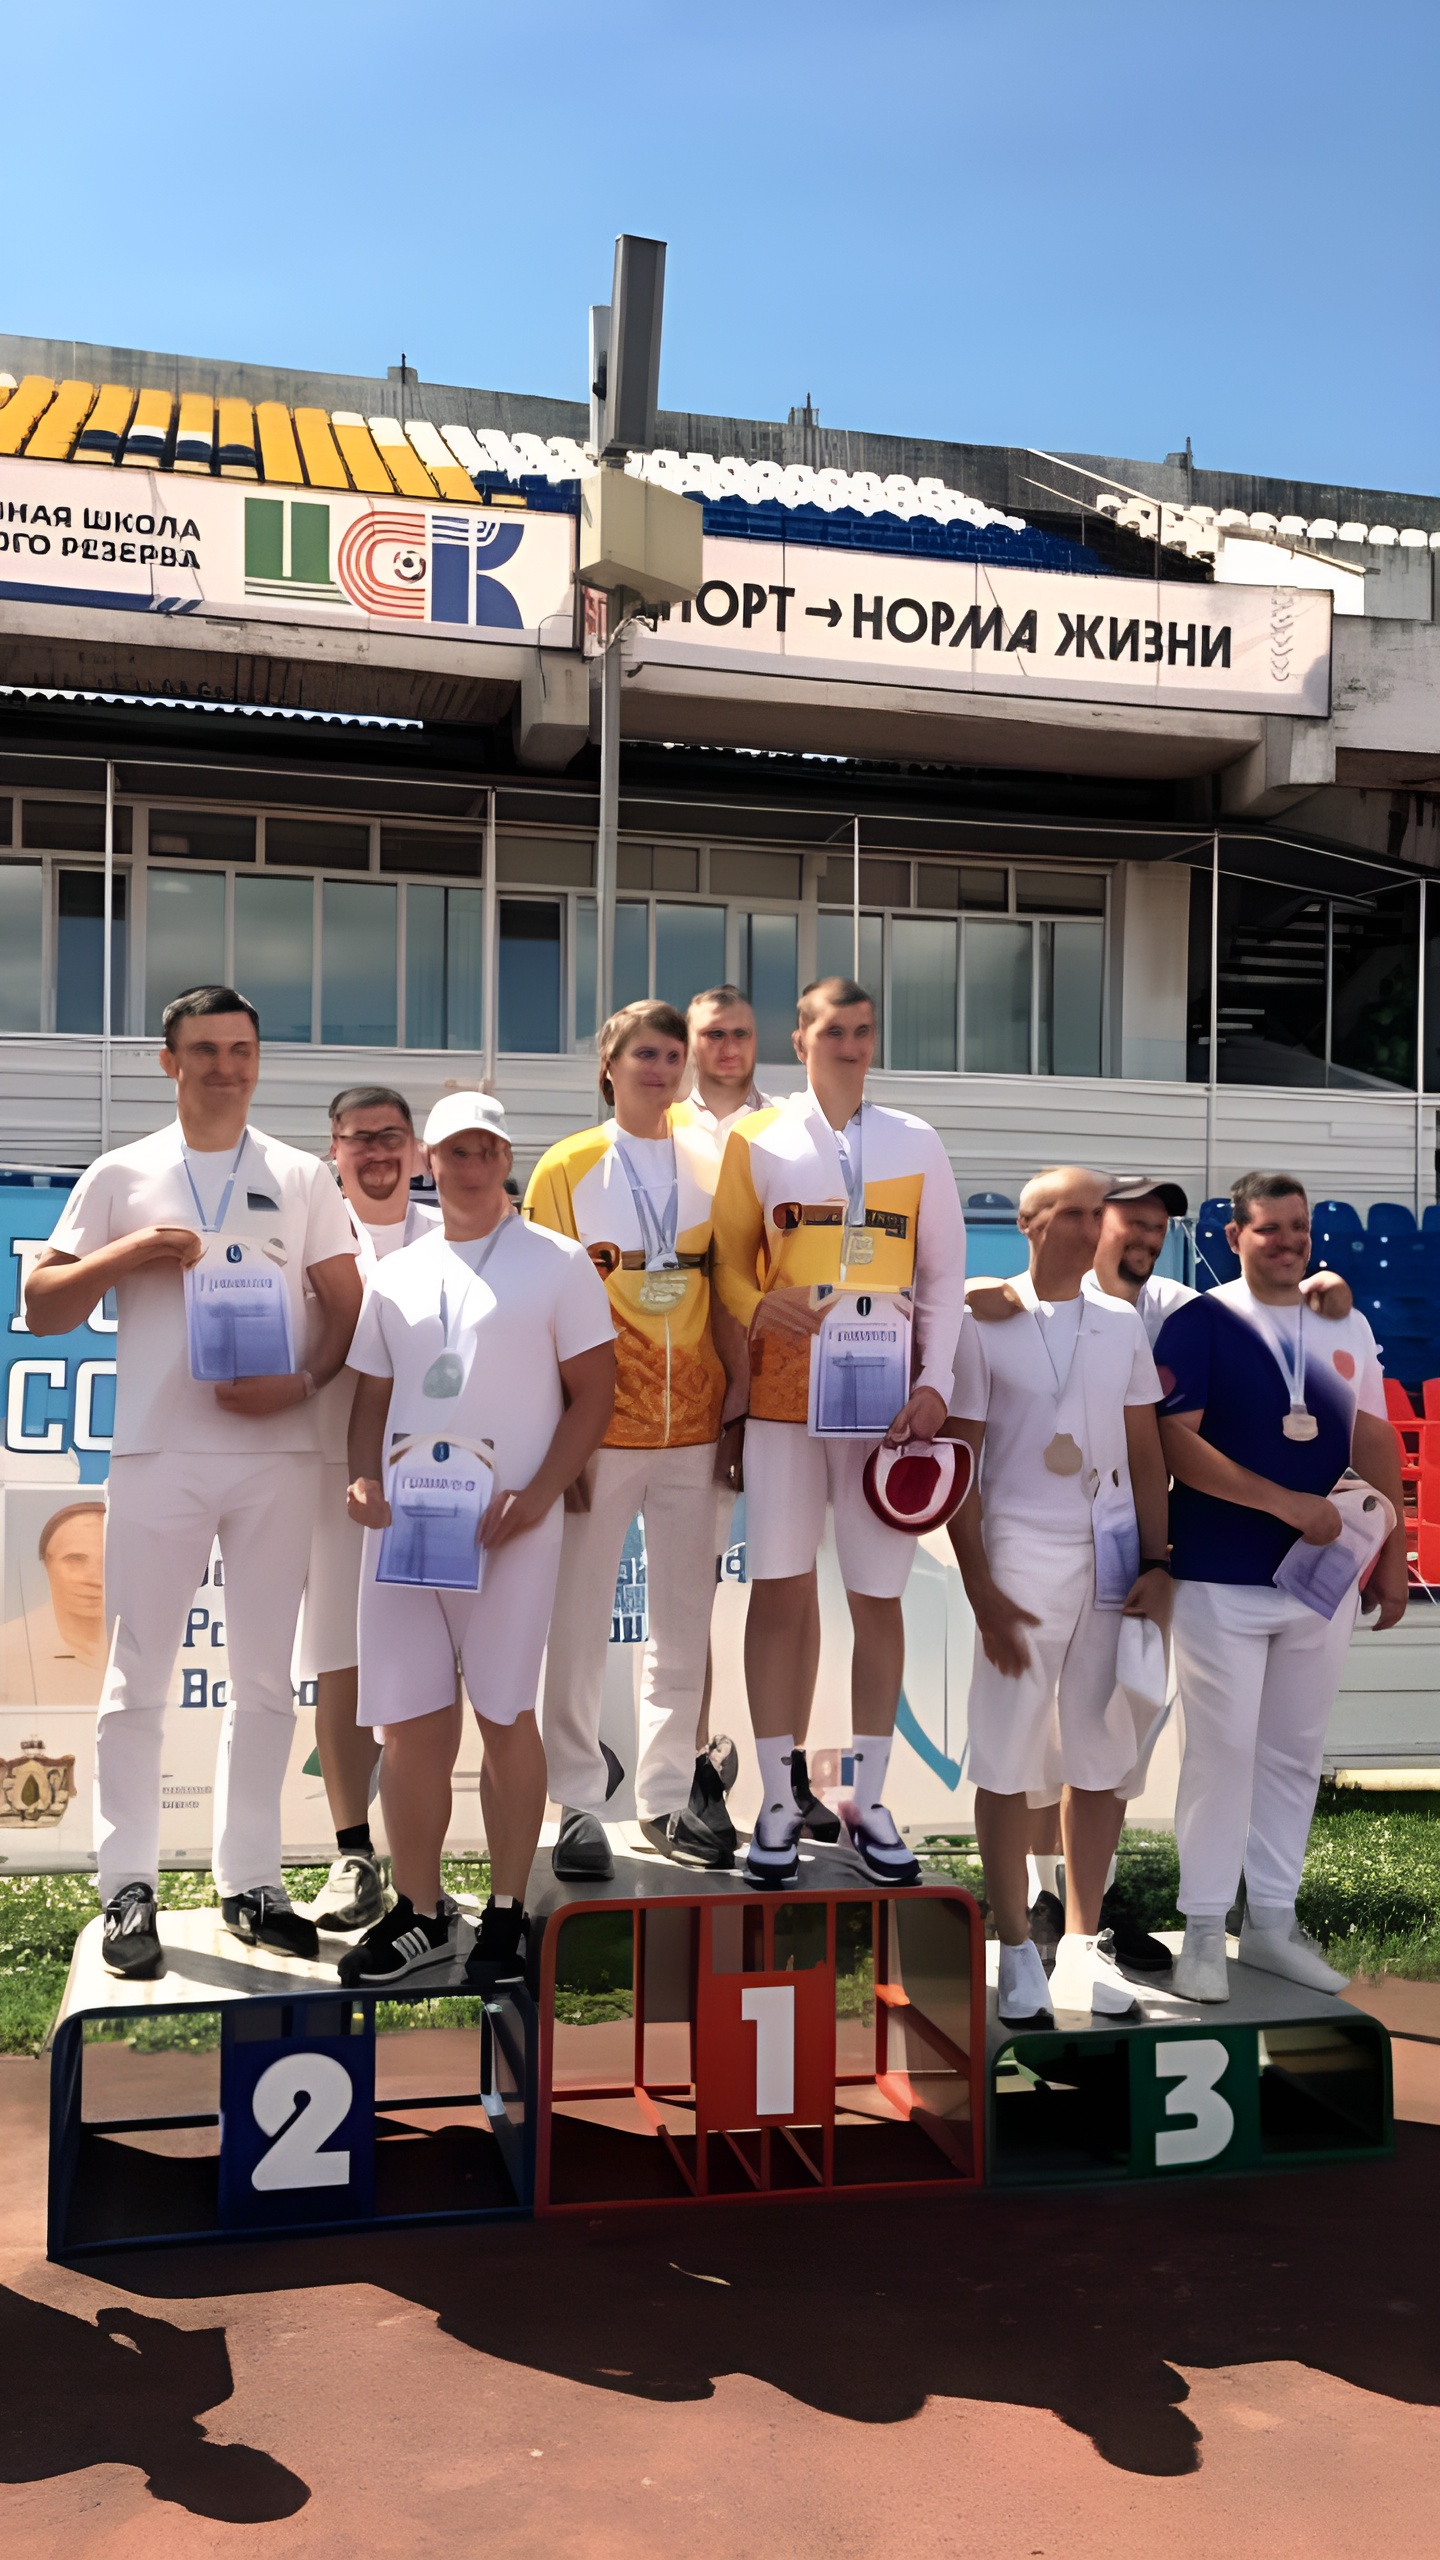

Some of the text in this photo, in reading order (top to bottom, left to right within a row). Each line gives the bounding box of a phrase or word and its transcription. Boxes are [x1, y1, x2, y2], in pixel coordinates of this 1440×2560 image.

[0, 501, 201, 542] НАЯ ШКОЛА
[61, 536, 201, 570] РЕЗЕРВА
[640, 579, 1232, 669] ОРТ НОРМА ЖИЗНИ
[741, 1985, 795, 2116] 1
[1155, 2038, 1235, 2167] 3
[251, 2052, 354, 2192] 2
